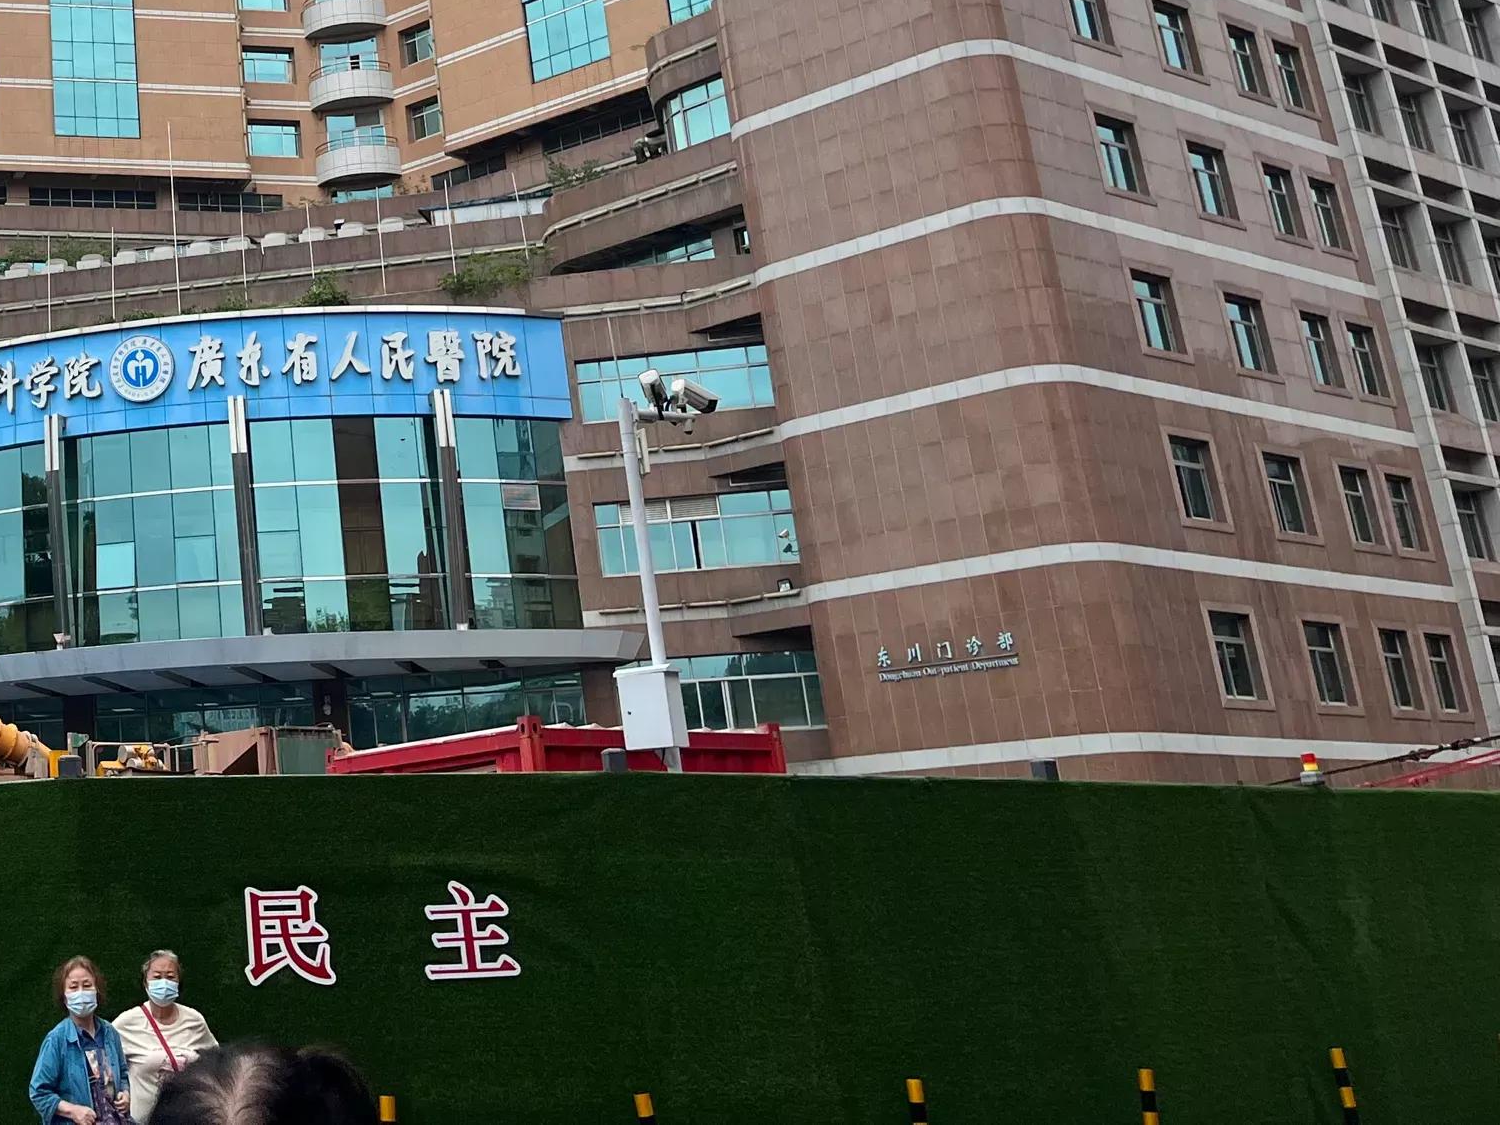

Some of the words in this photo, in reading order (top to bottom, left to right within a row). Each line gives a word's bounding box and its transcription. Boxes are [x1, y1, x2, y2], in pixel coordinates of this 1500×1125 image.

[877, 632, 1014, 668] 东川门诊部
[245, 880, 521, 986] 民主
